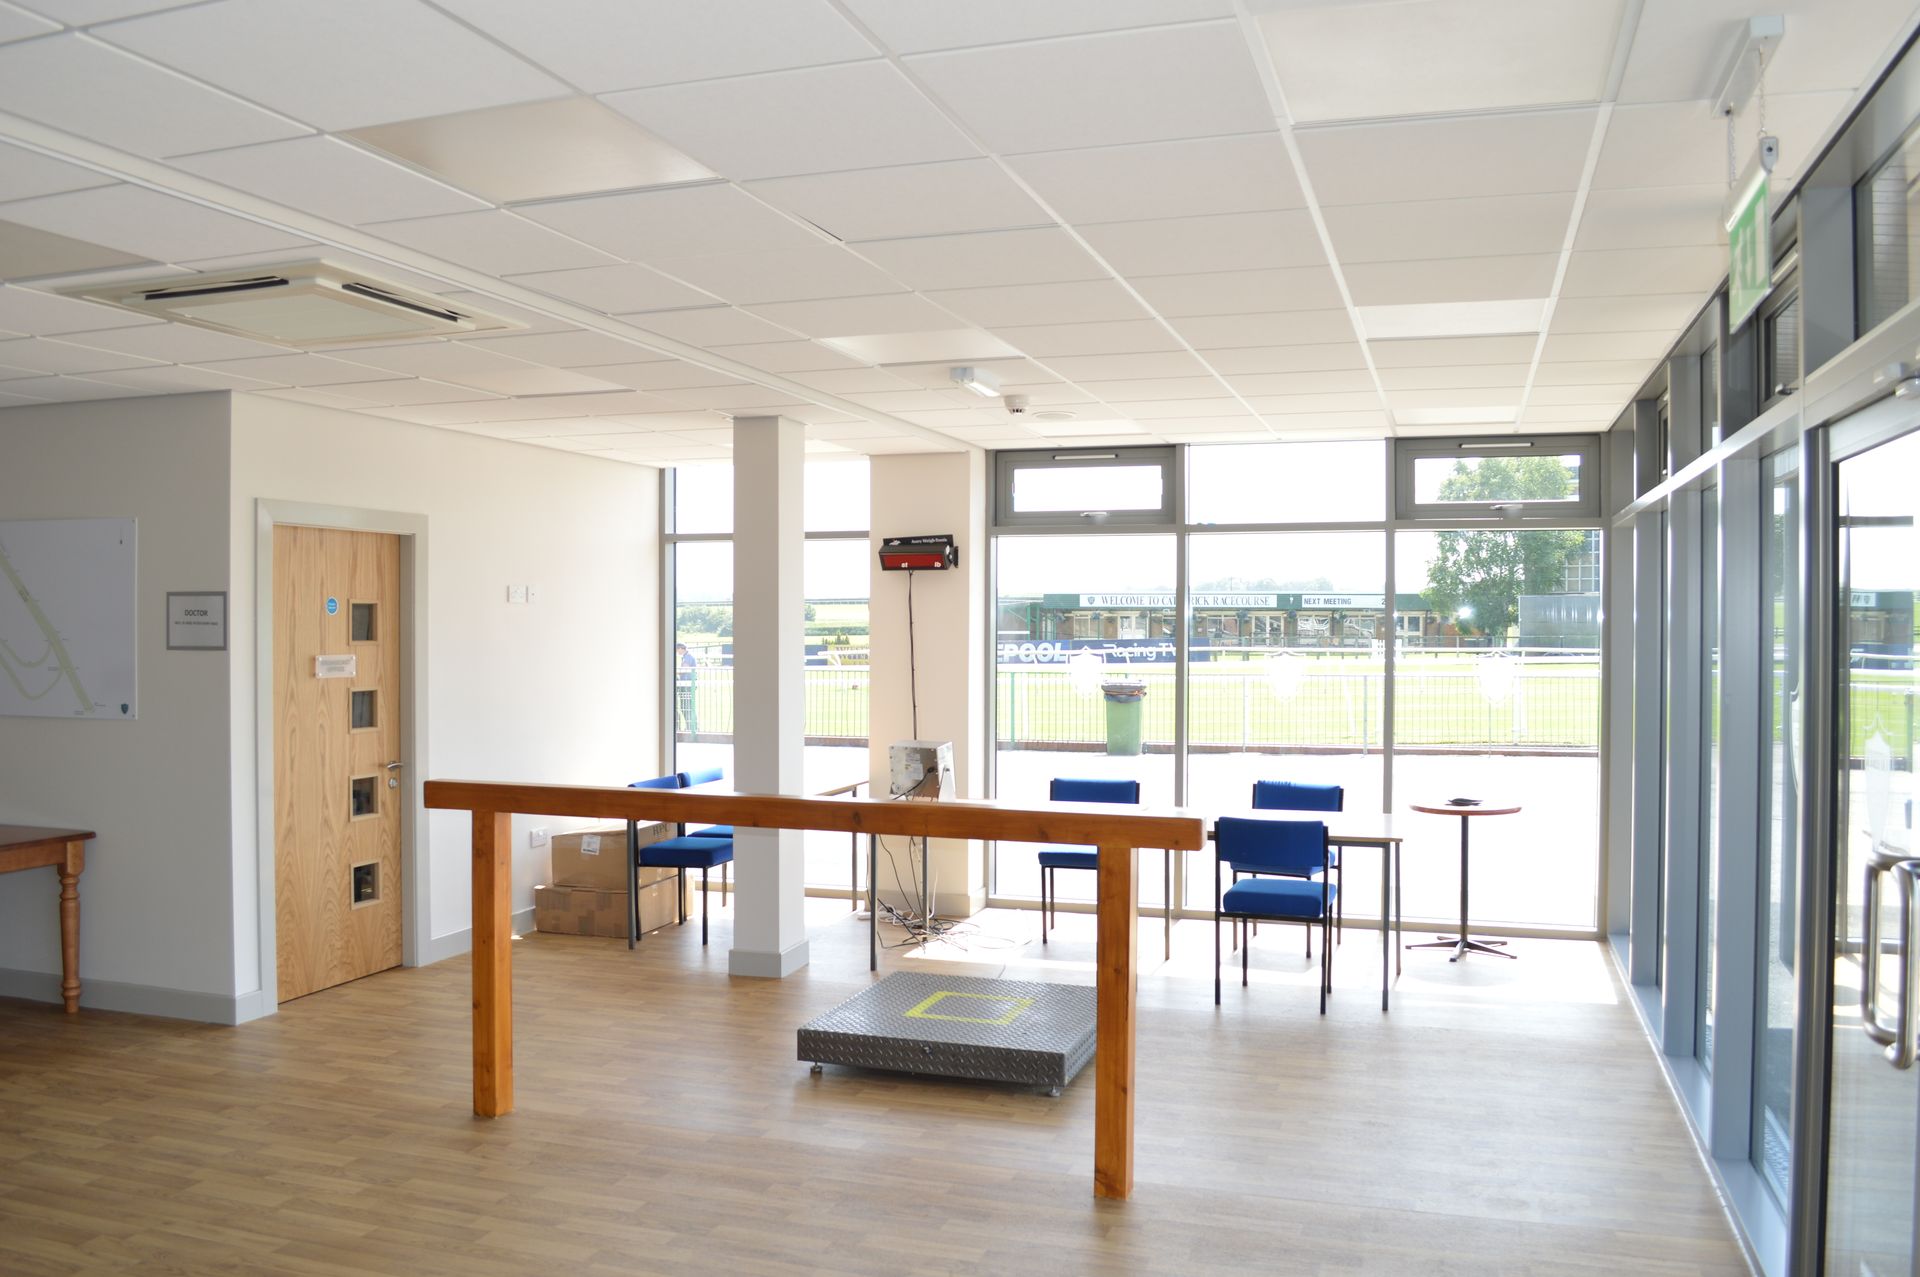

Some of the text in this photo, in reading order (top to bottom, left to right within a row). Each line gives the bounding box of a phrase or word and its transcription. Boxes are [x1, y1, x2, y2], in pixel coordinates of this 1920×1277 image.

[1101, 596, 1146, 605] WELCOME
[1148, 596, 1159, 605] TO
[1213, 596, 1270, 606] RACECOURSE
[184, 609, 208, 617] DOCTOR
[1103, 642, 1156, 661] Racing
